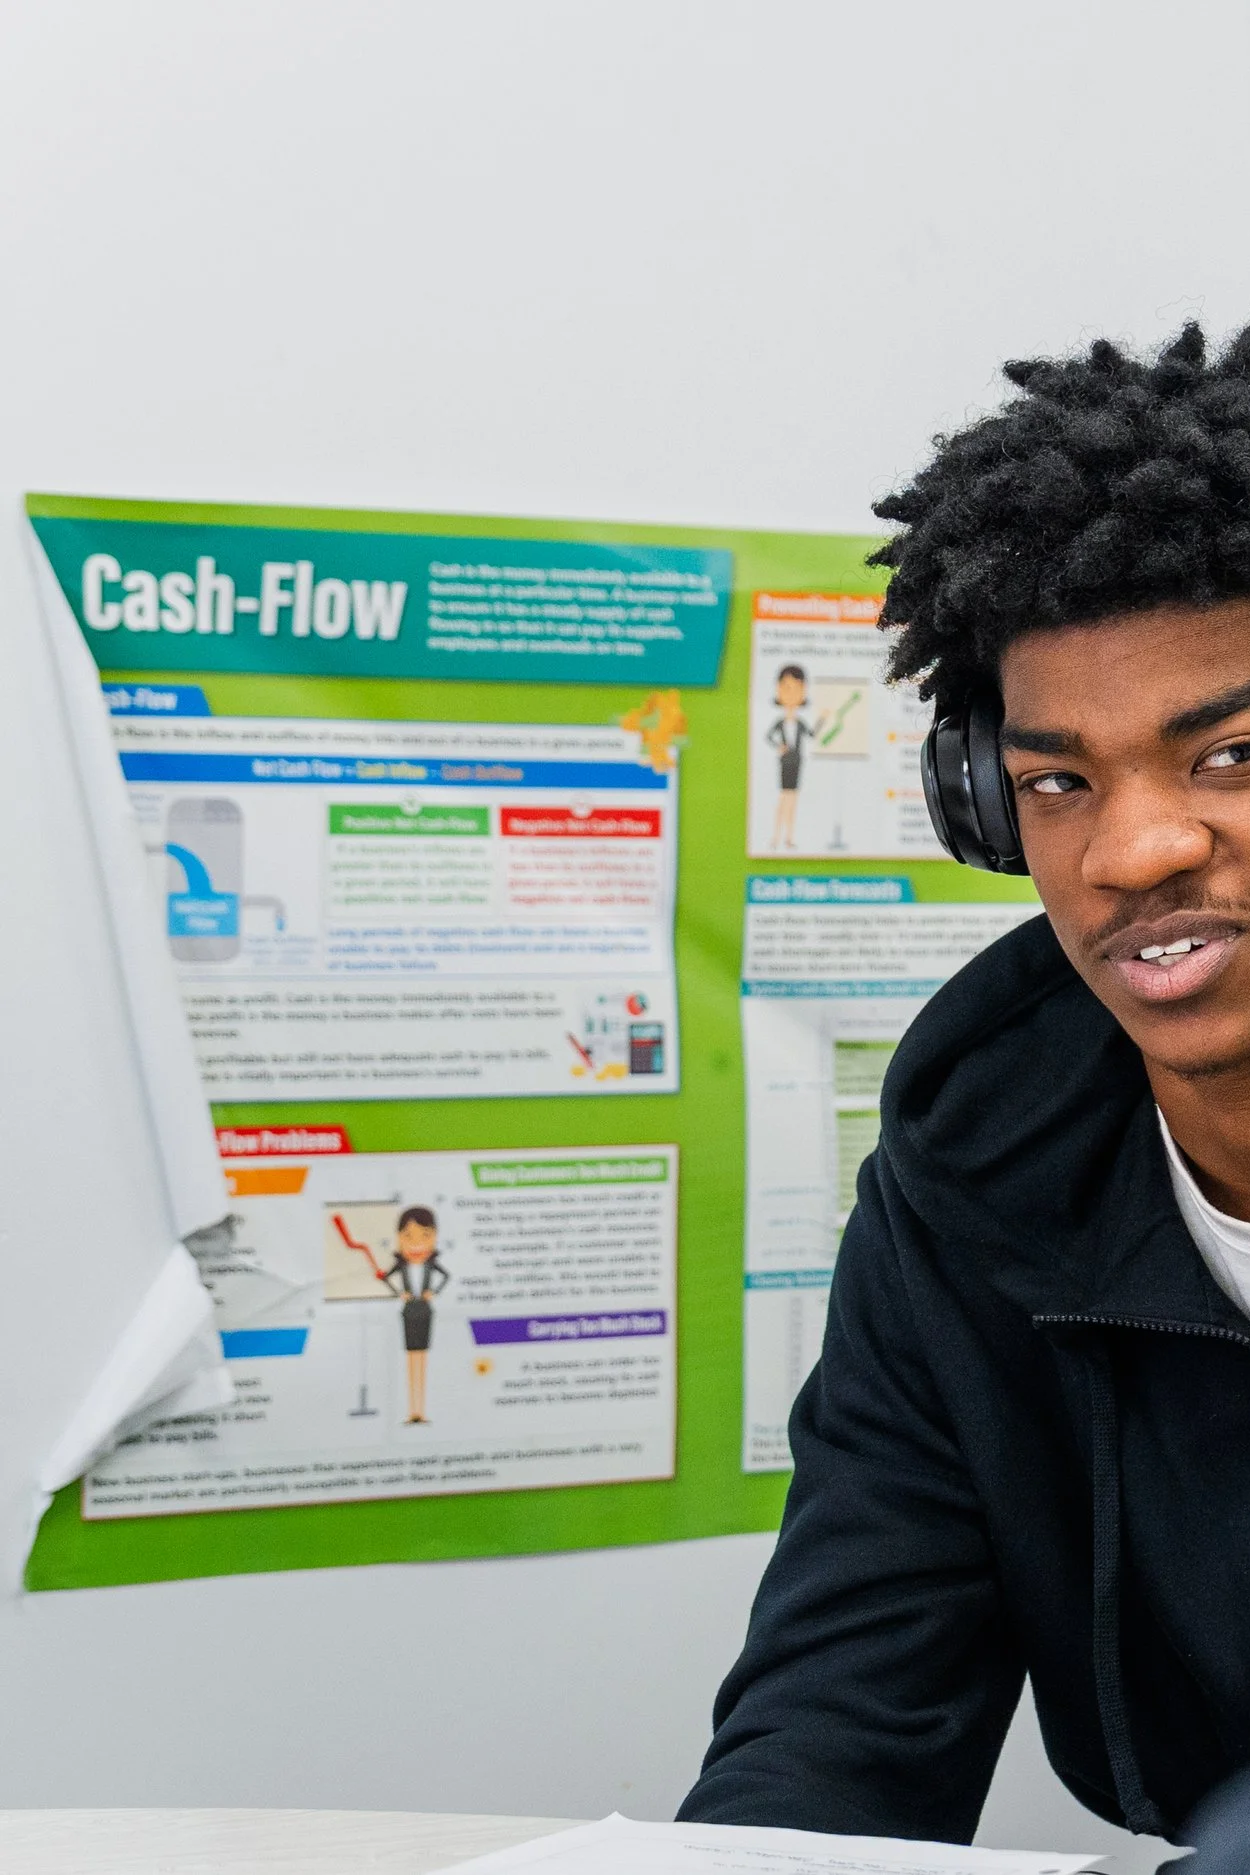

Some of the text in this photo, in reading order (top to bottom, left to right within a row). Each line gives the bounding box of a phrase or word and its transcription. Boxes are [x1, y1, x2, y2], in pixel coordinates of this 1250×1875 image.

[82, 553, 408, 641] Cash-Flow
[104, 687, 178, 710] ash-Flow
[260, 1129, 342, 1152] Problems
